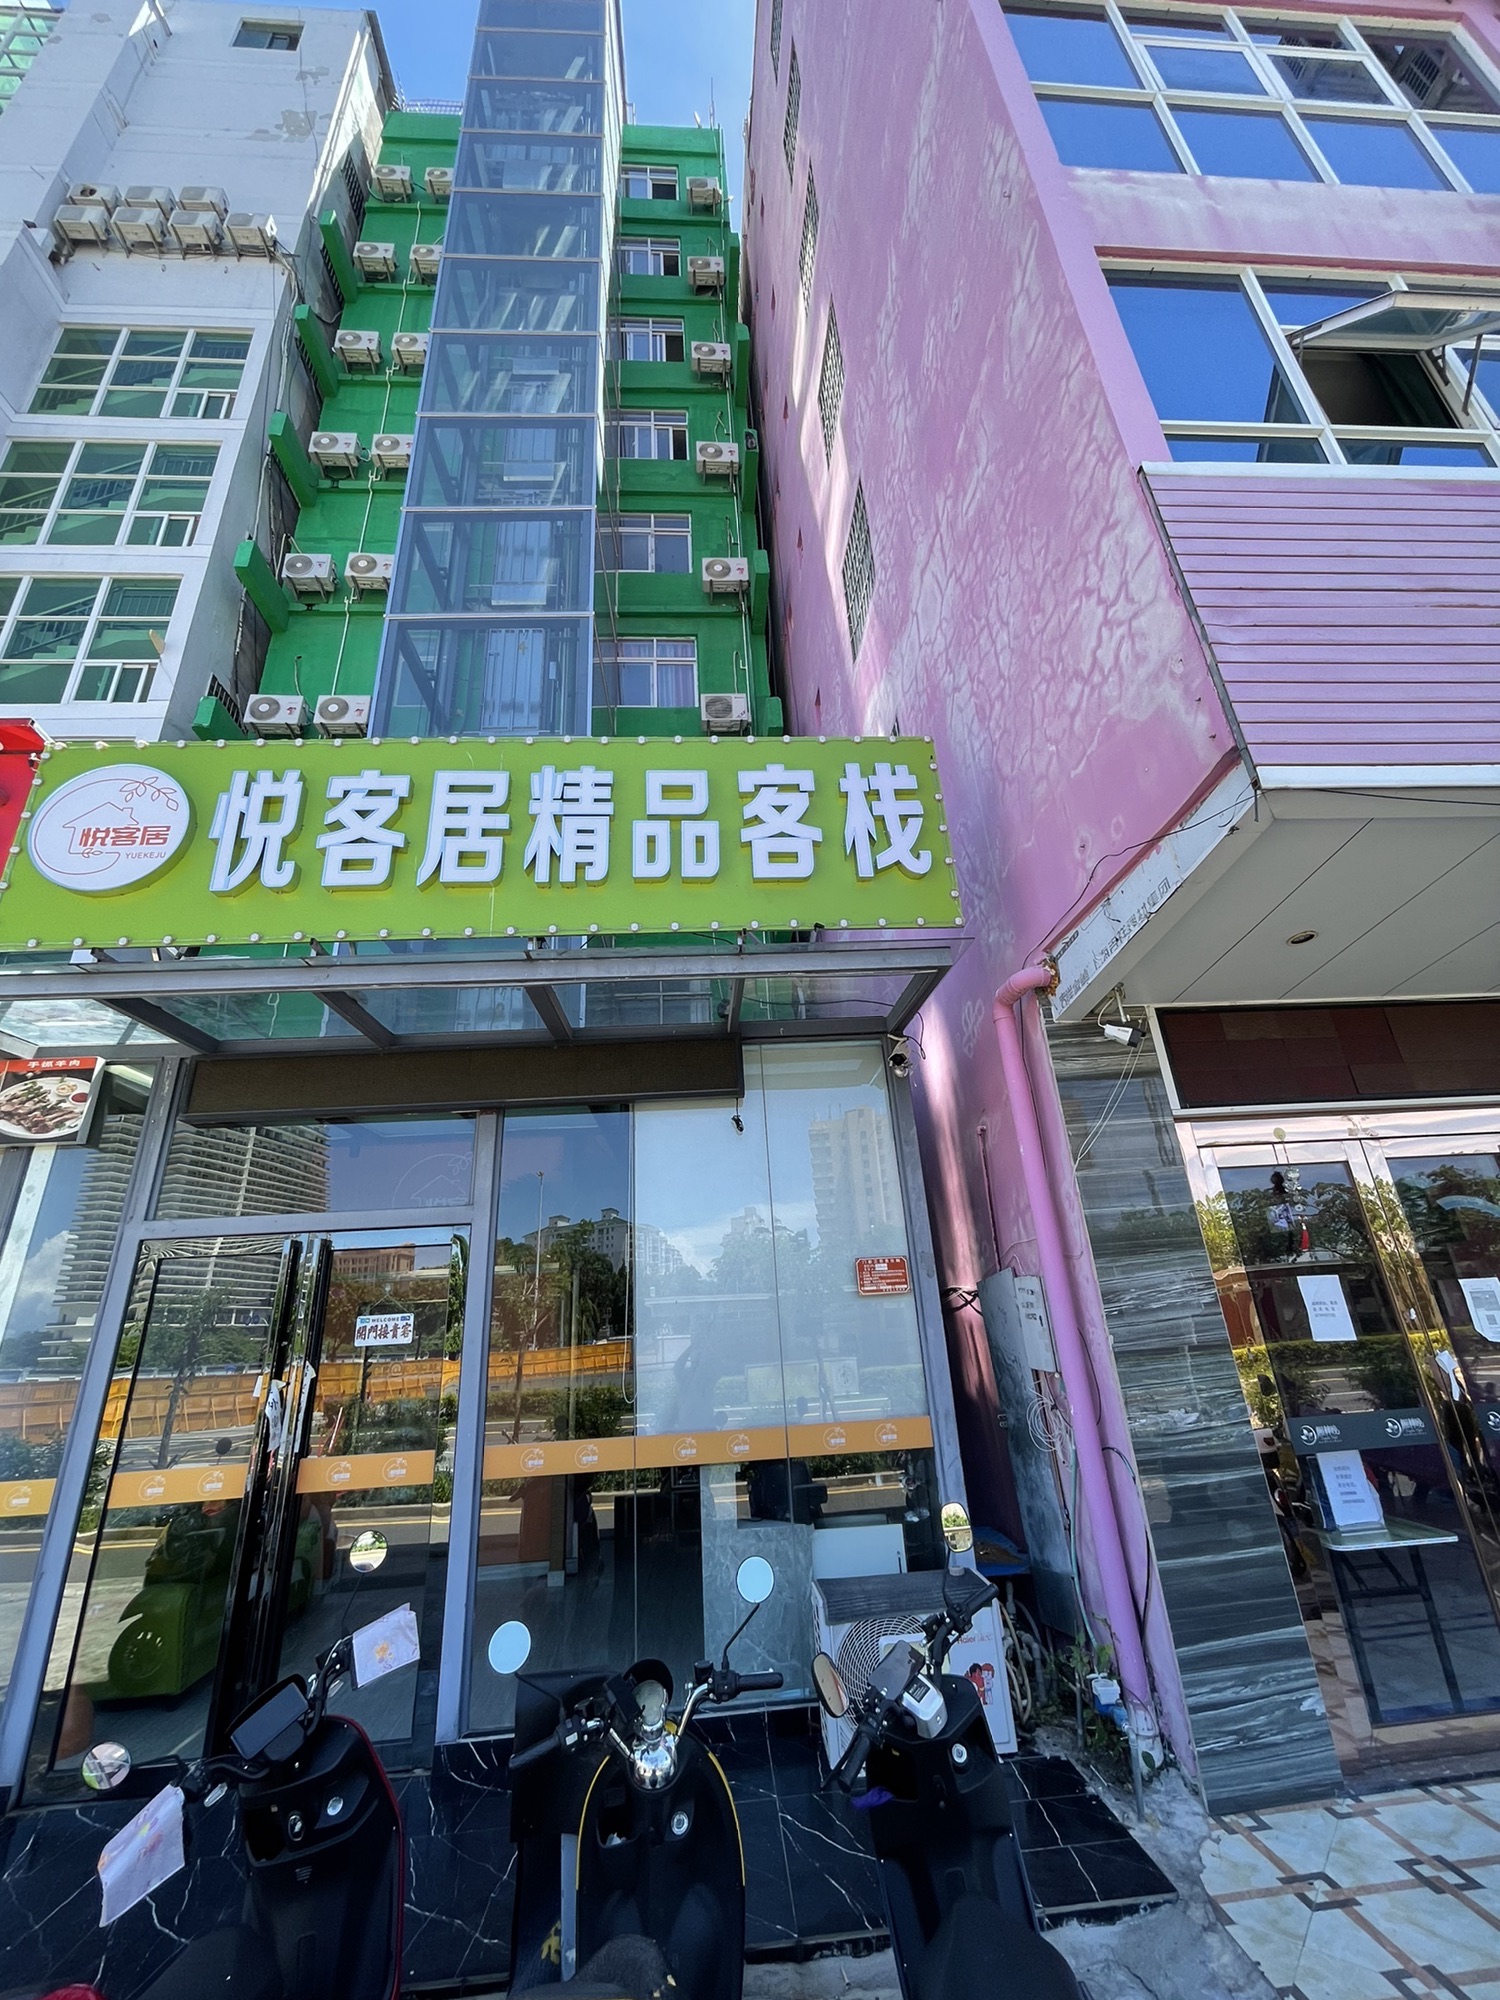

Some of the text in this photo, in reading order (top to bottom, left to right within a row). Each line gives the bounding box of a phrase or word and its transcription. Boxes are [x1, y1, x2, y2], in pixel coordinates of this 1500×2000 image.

[79, 825, 172, 847] 悦客居
[208, 763, 933, 894] 悦客居精品客栈
[125, 851, 167, 859] YUEKEJU
[27, 1059, 81, 1068] 手抓羊肉
